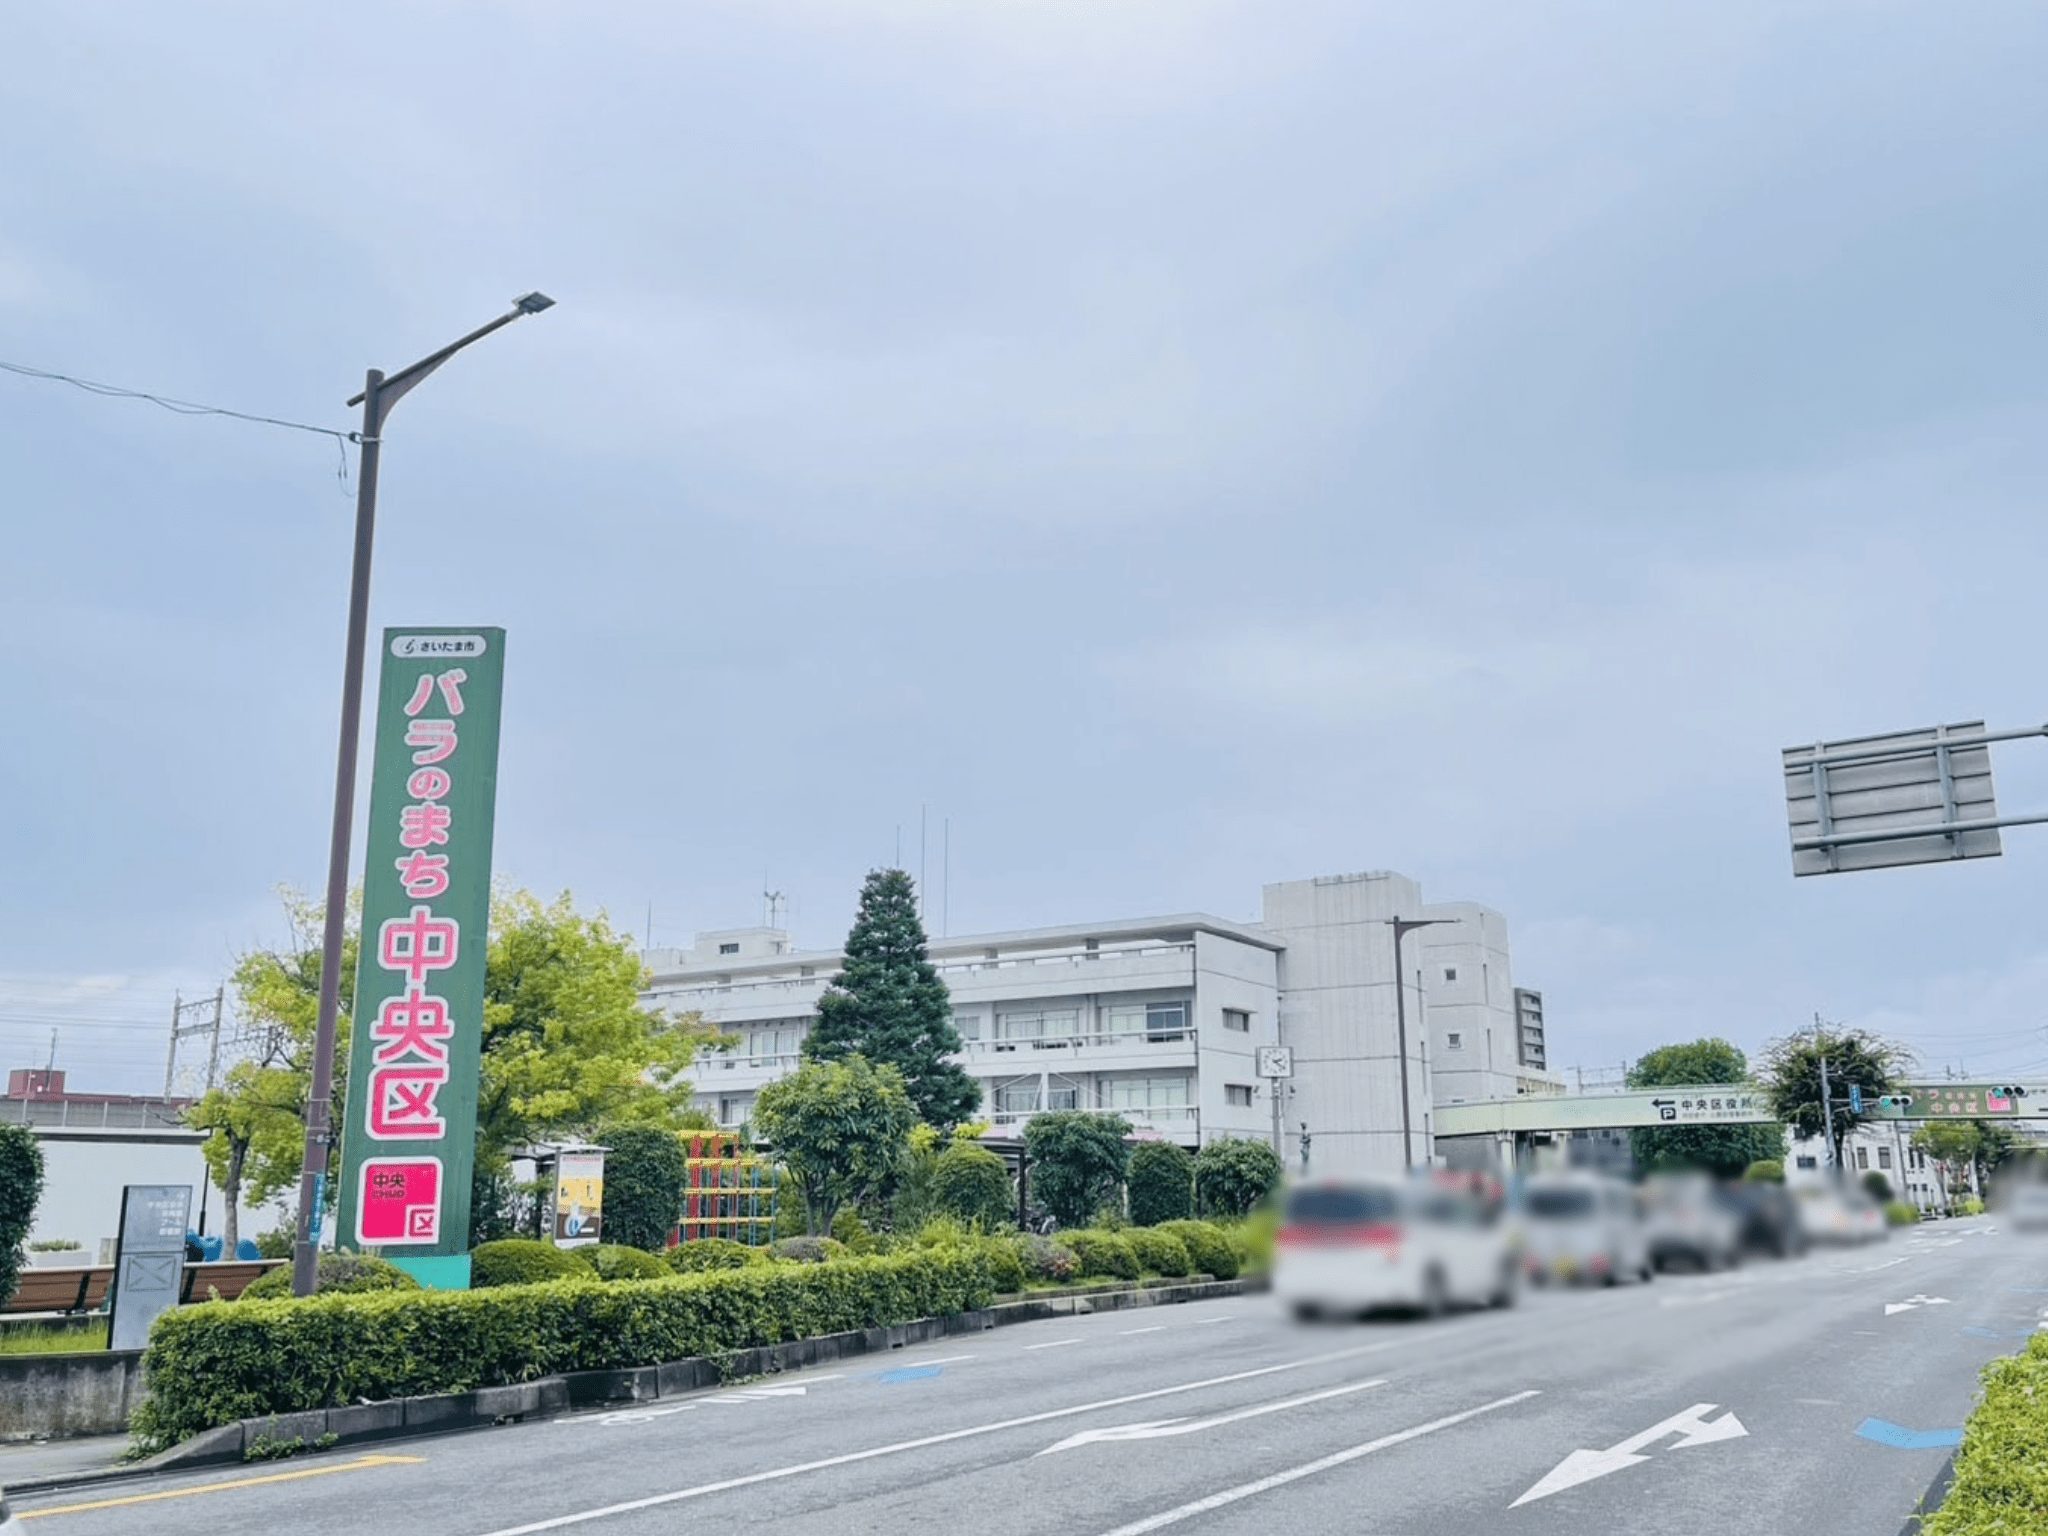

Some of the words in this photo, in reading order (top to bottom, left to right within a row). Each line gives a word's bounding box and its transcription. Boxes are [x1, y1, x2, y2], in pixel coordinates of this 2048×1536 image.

[420, 641, 475, 652] さいたま市
[373, 1173, 405, 1189] 中央
[409, 1208, 435, 1237] 区
